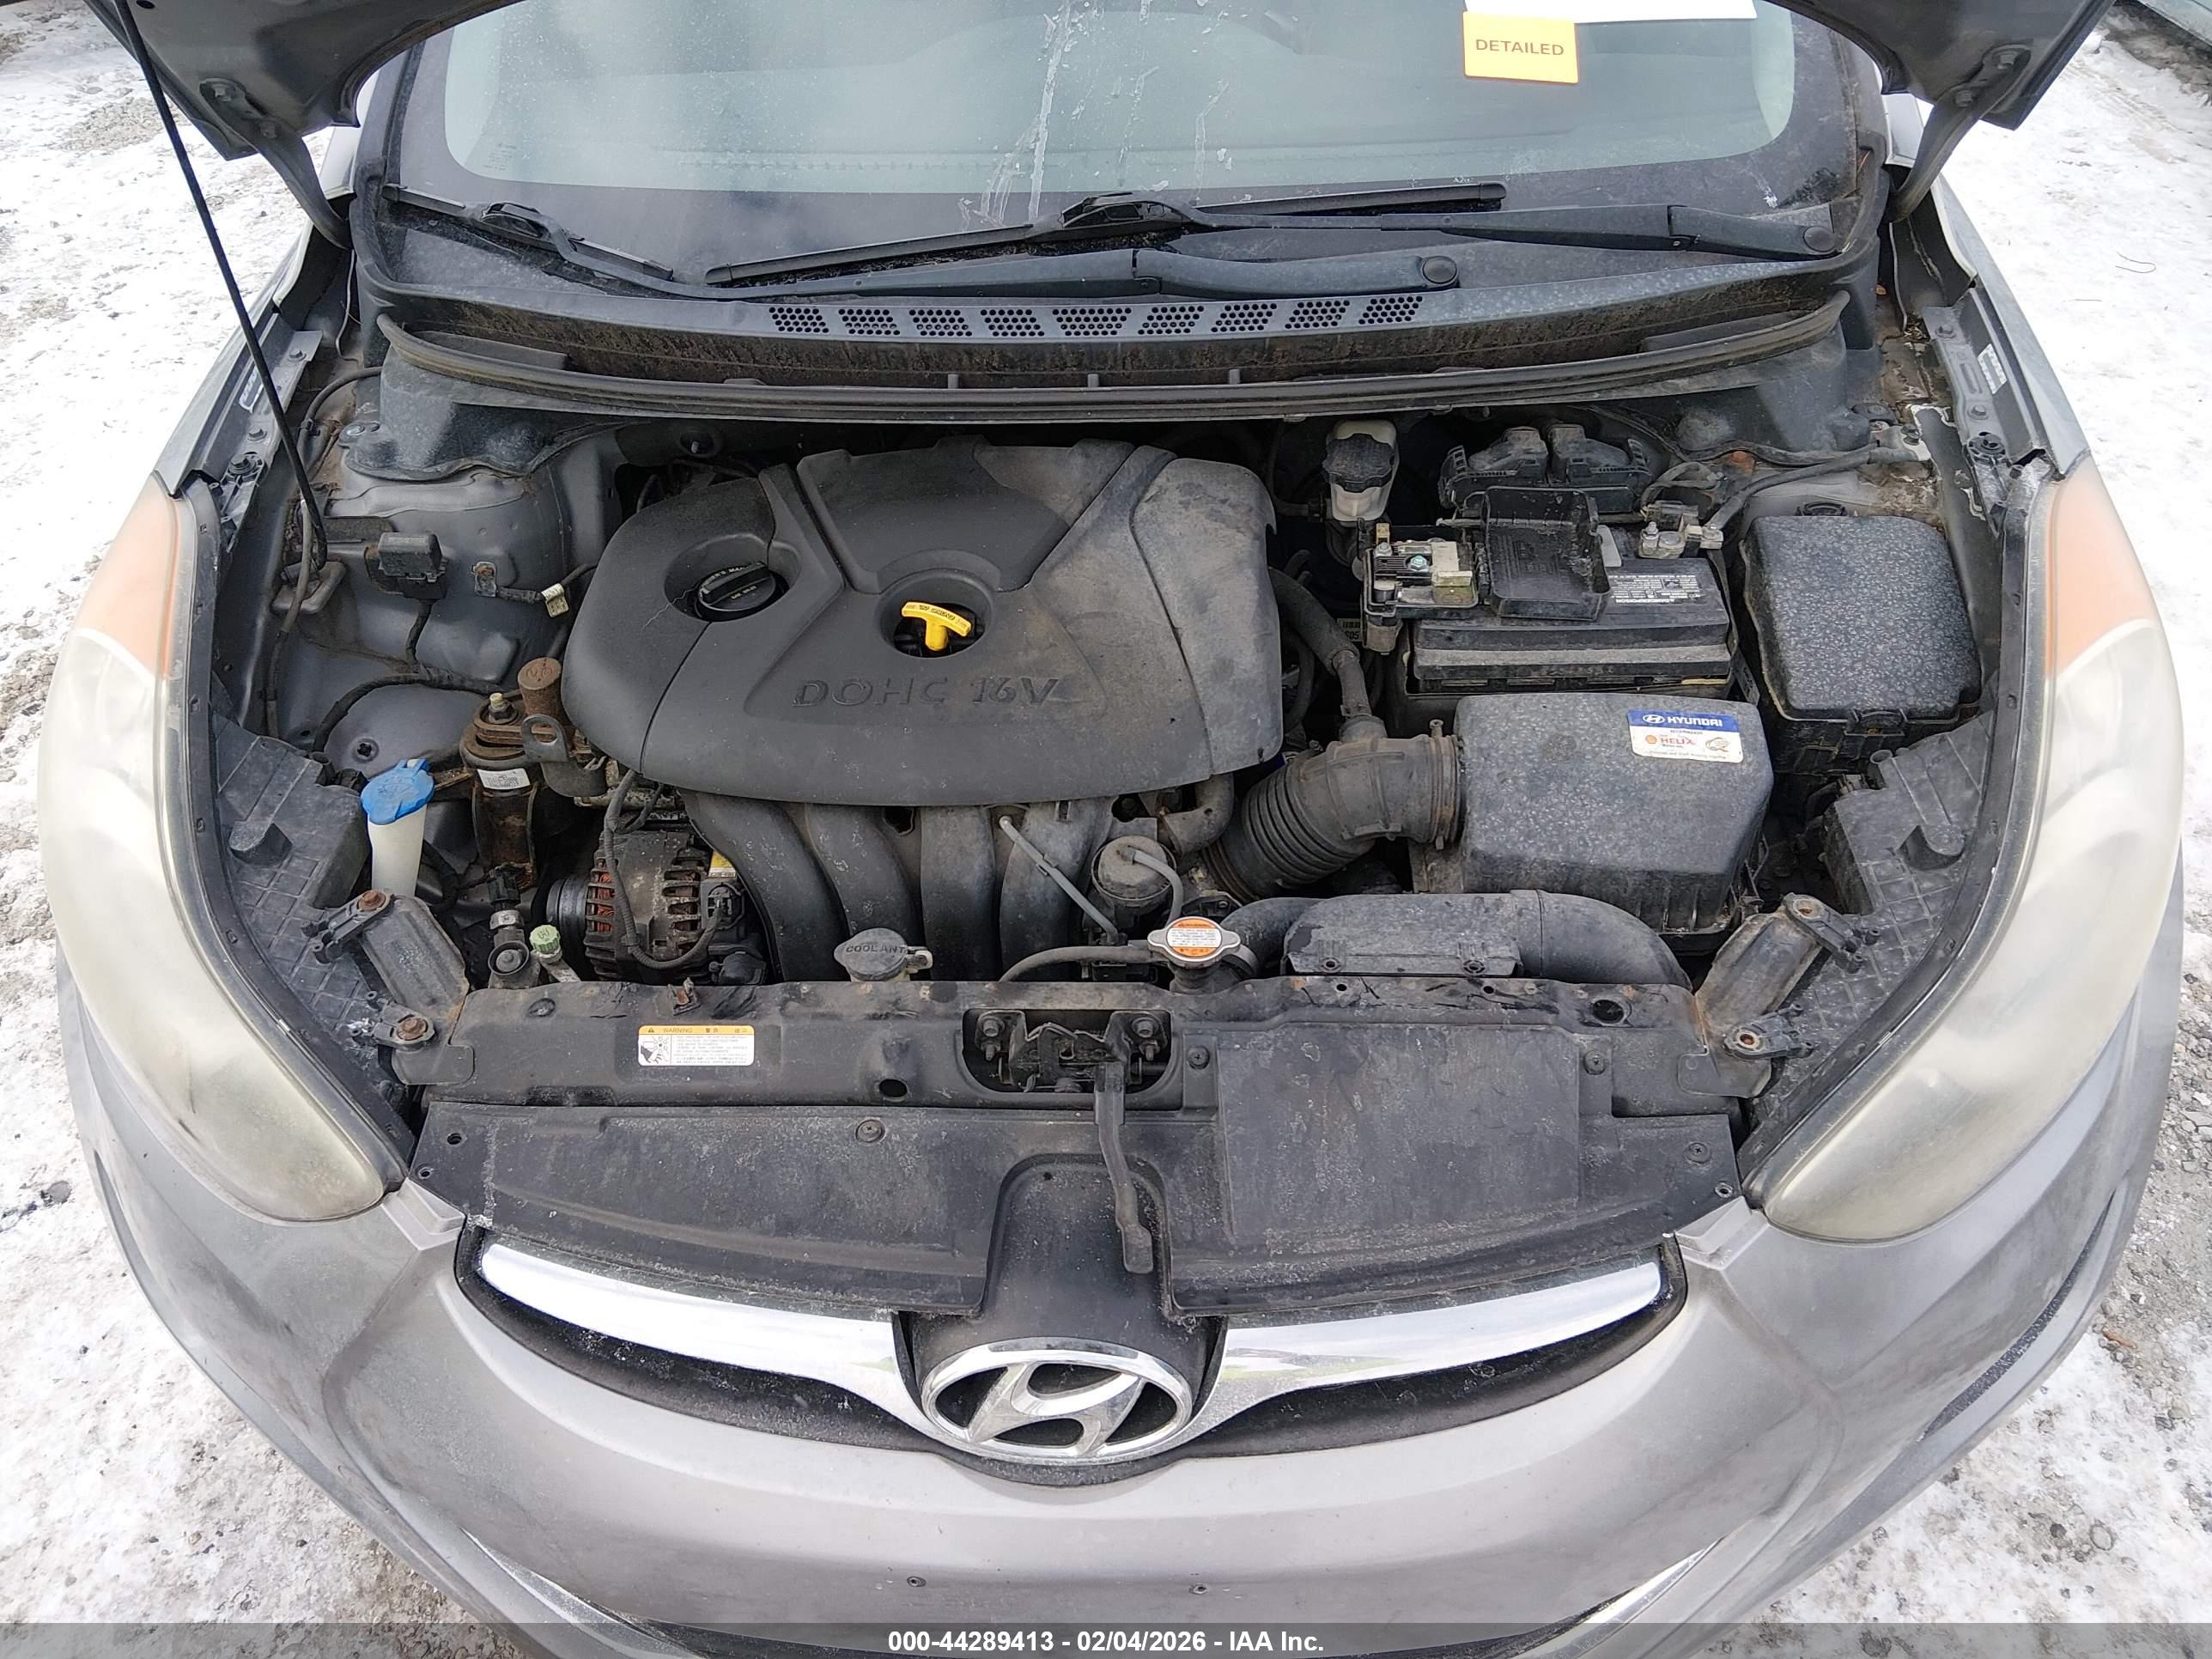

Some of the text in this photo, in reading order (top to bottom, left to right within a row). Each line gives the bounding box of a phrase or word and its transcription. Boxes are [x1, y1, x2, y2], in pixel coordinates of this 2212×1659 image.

[1475, 39, 1565, 56] DETAILED
[791, 677, 1059, 707] DOHC 16V
[1667, 715, 1723, 727] HYUNDAI
[845, 945, 905, 954] COOLANT
